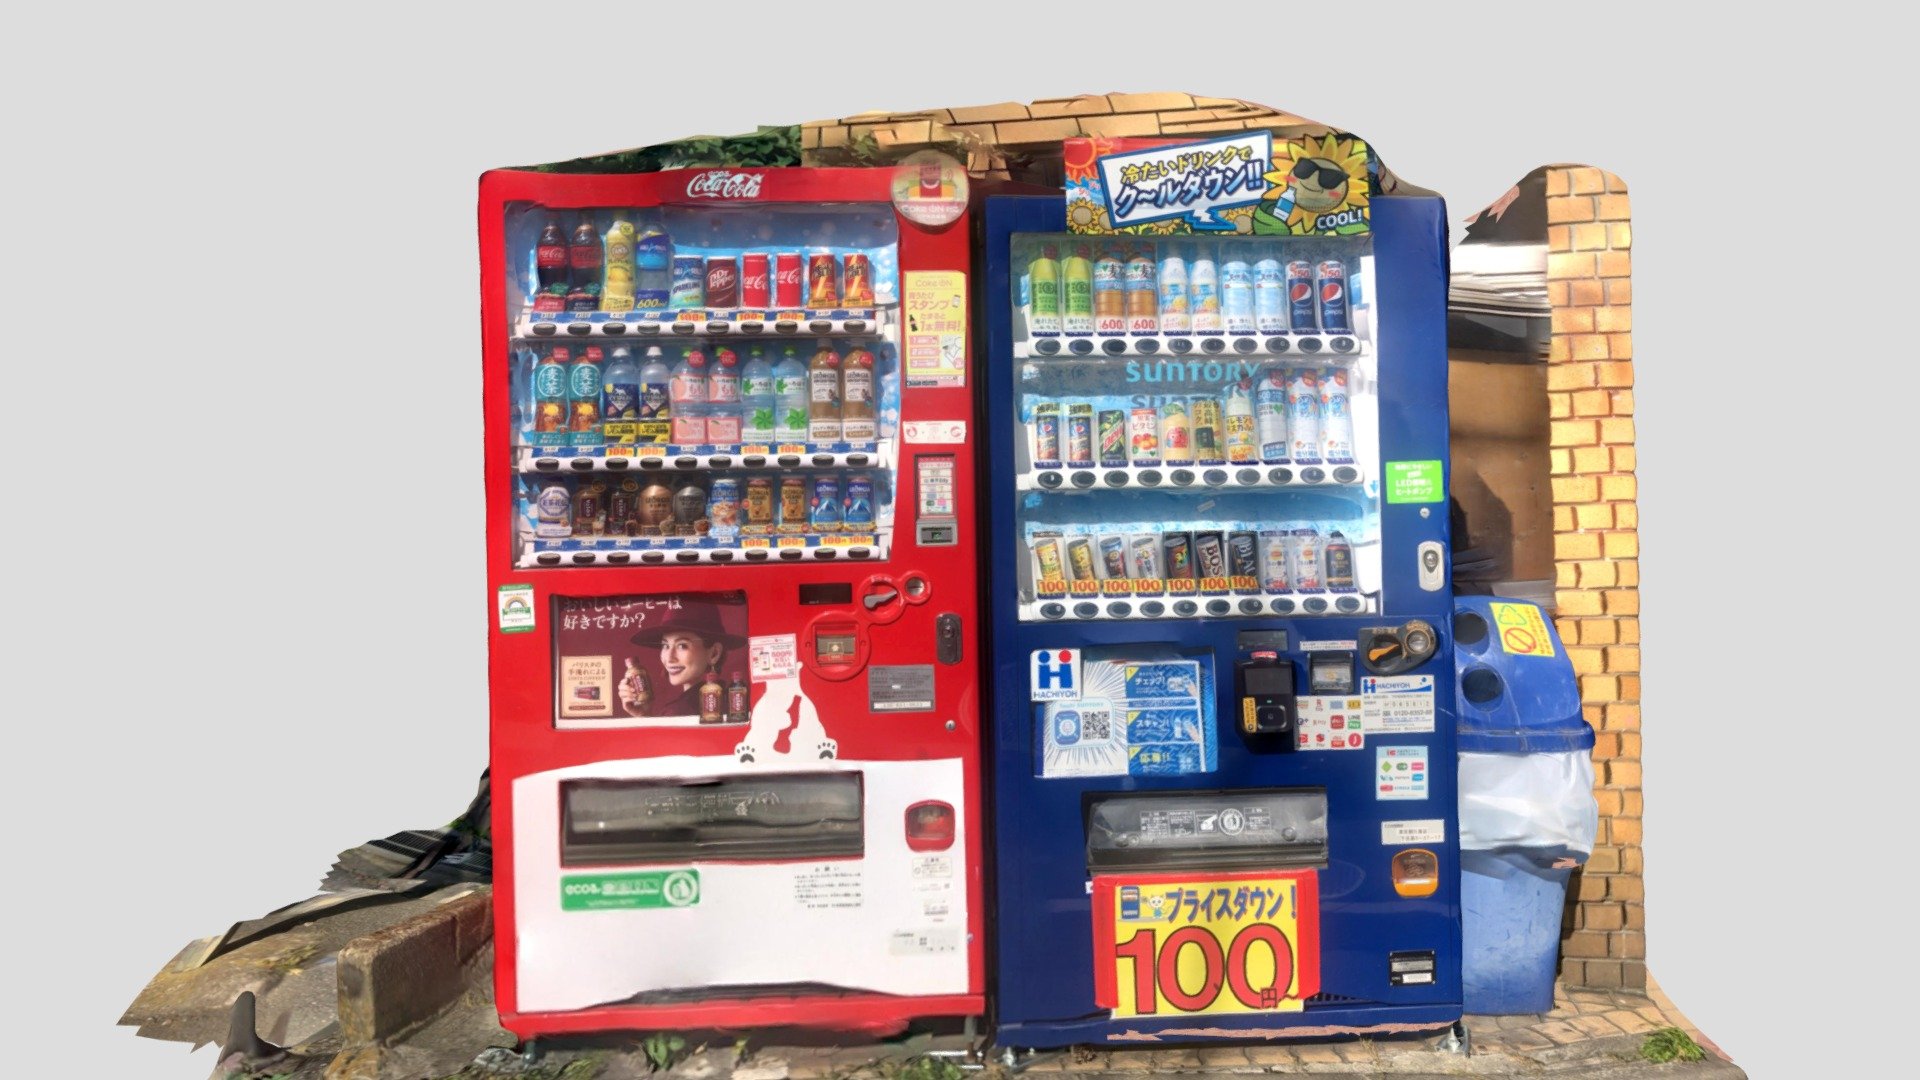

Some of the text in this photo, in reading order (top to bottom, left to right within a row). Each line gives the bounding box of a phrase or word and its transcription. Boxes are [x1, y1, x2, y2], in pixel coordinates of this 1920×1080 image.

[1120, 144, 1253, 184] 冷たいドリンクで
[1315, 209, 1363, 231] COOL!
[1033, 691, 1078, 699] HACHIYOH
